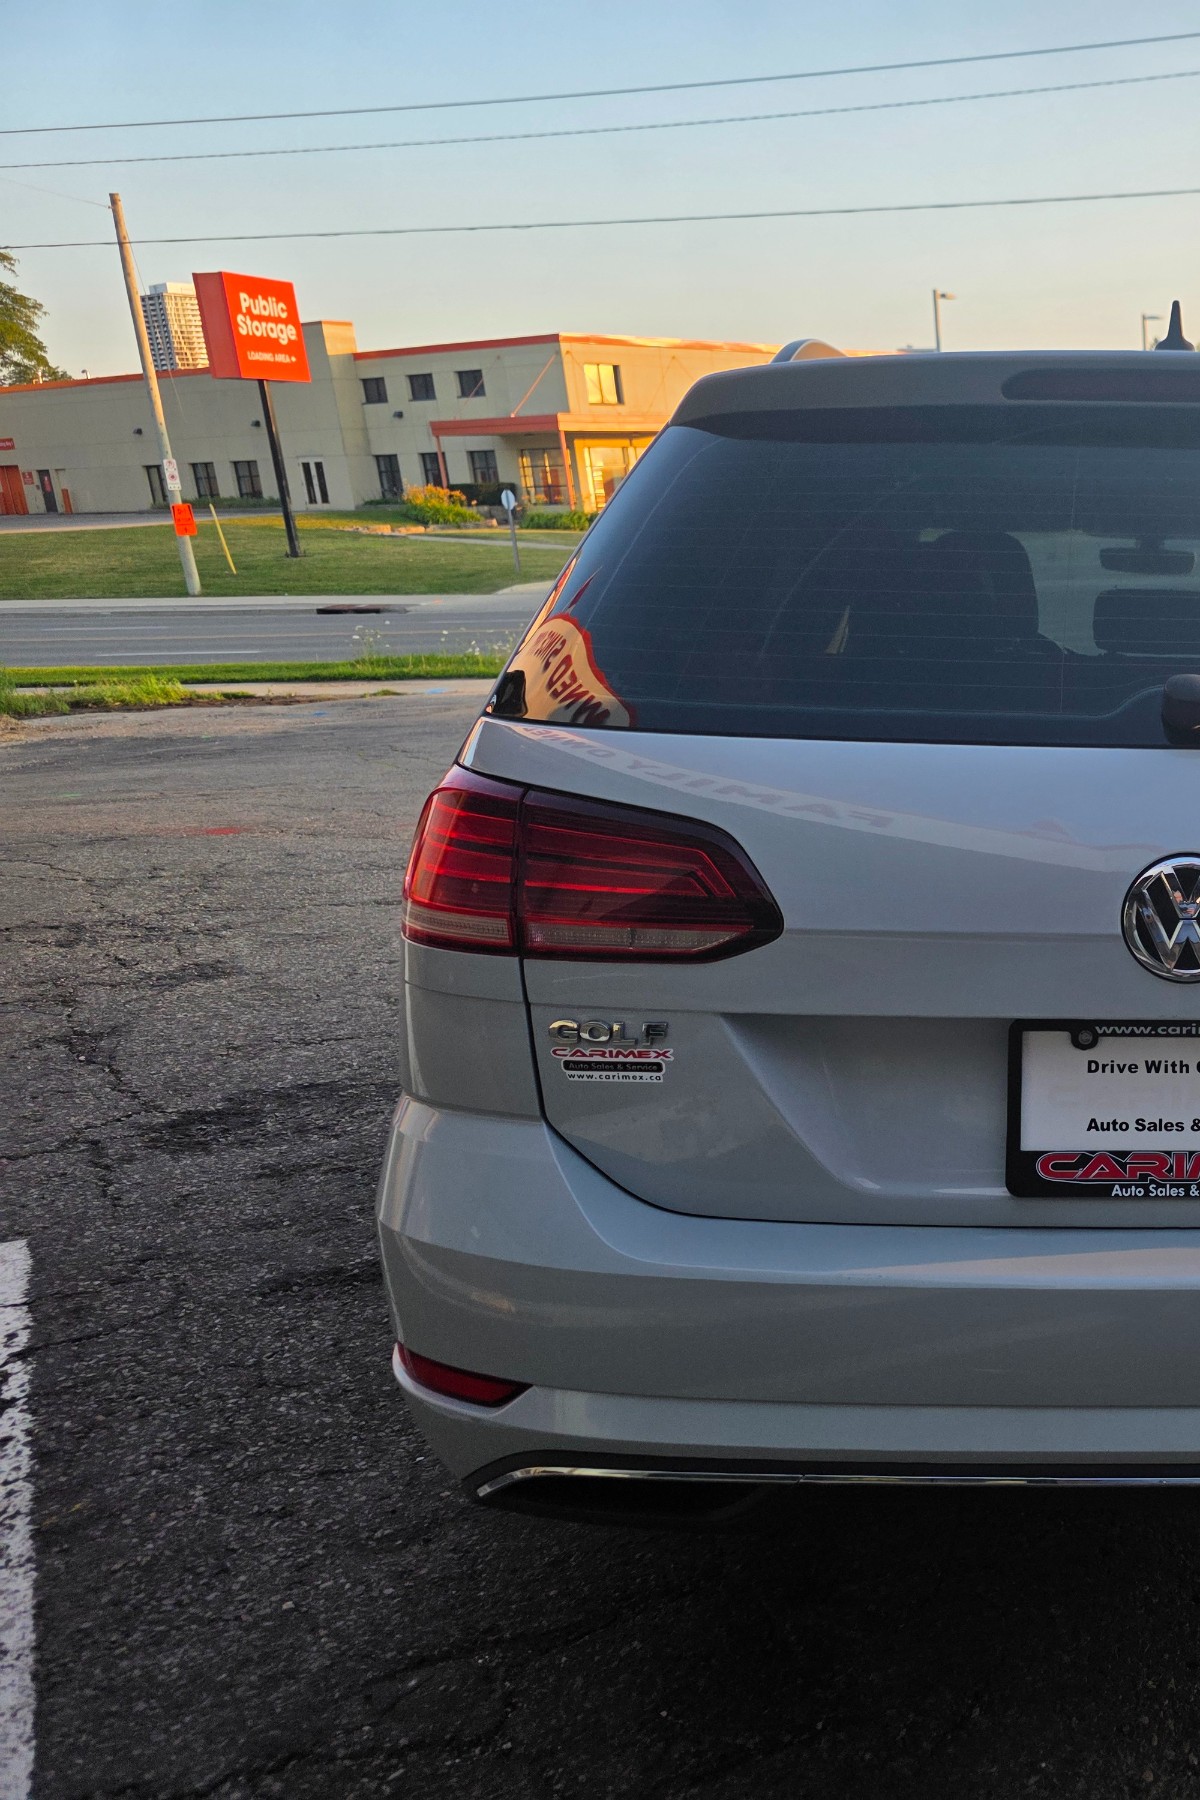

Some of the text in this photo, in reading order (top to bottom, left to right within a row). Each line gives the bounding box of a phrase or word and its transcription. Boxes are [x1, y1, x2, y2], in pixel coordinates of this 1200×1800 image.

[239, 292, 288, 319] Public
[236, 314, 297, 345] Storage
[548, 1019, 669, 1046] GOLF
[551, 1048, 673, 1060] CARIMEX
[569, 1062, 589, 1070] Auto
[591, 1062, 614, 1071] Sales
[627, 1063, 658, 1071] Service
[1087, 1059, 1139, 1075] Drive
[1145, 1059, 1190, 1075] With
[567, 1072, 662, 1081] www.carimex.ca
[1086, 1117, 1130, 1133] Auto
[1134, 1117, 1185, 1133] Sales
[1111, 1184, 1144, 1197] Auto
[1148, 1184, 1186, 1197] Sales
[1189, 1184, 1200, 1197] &
